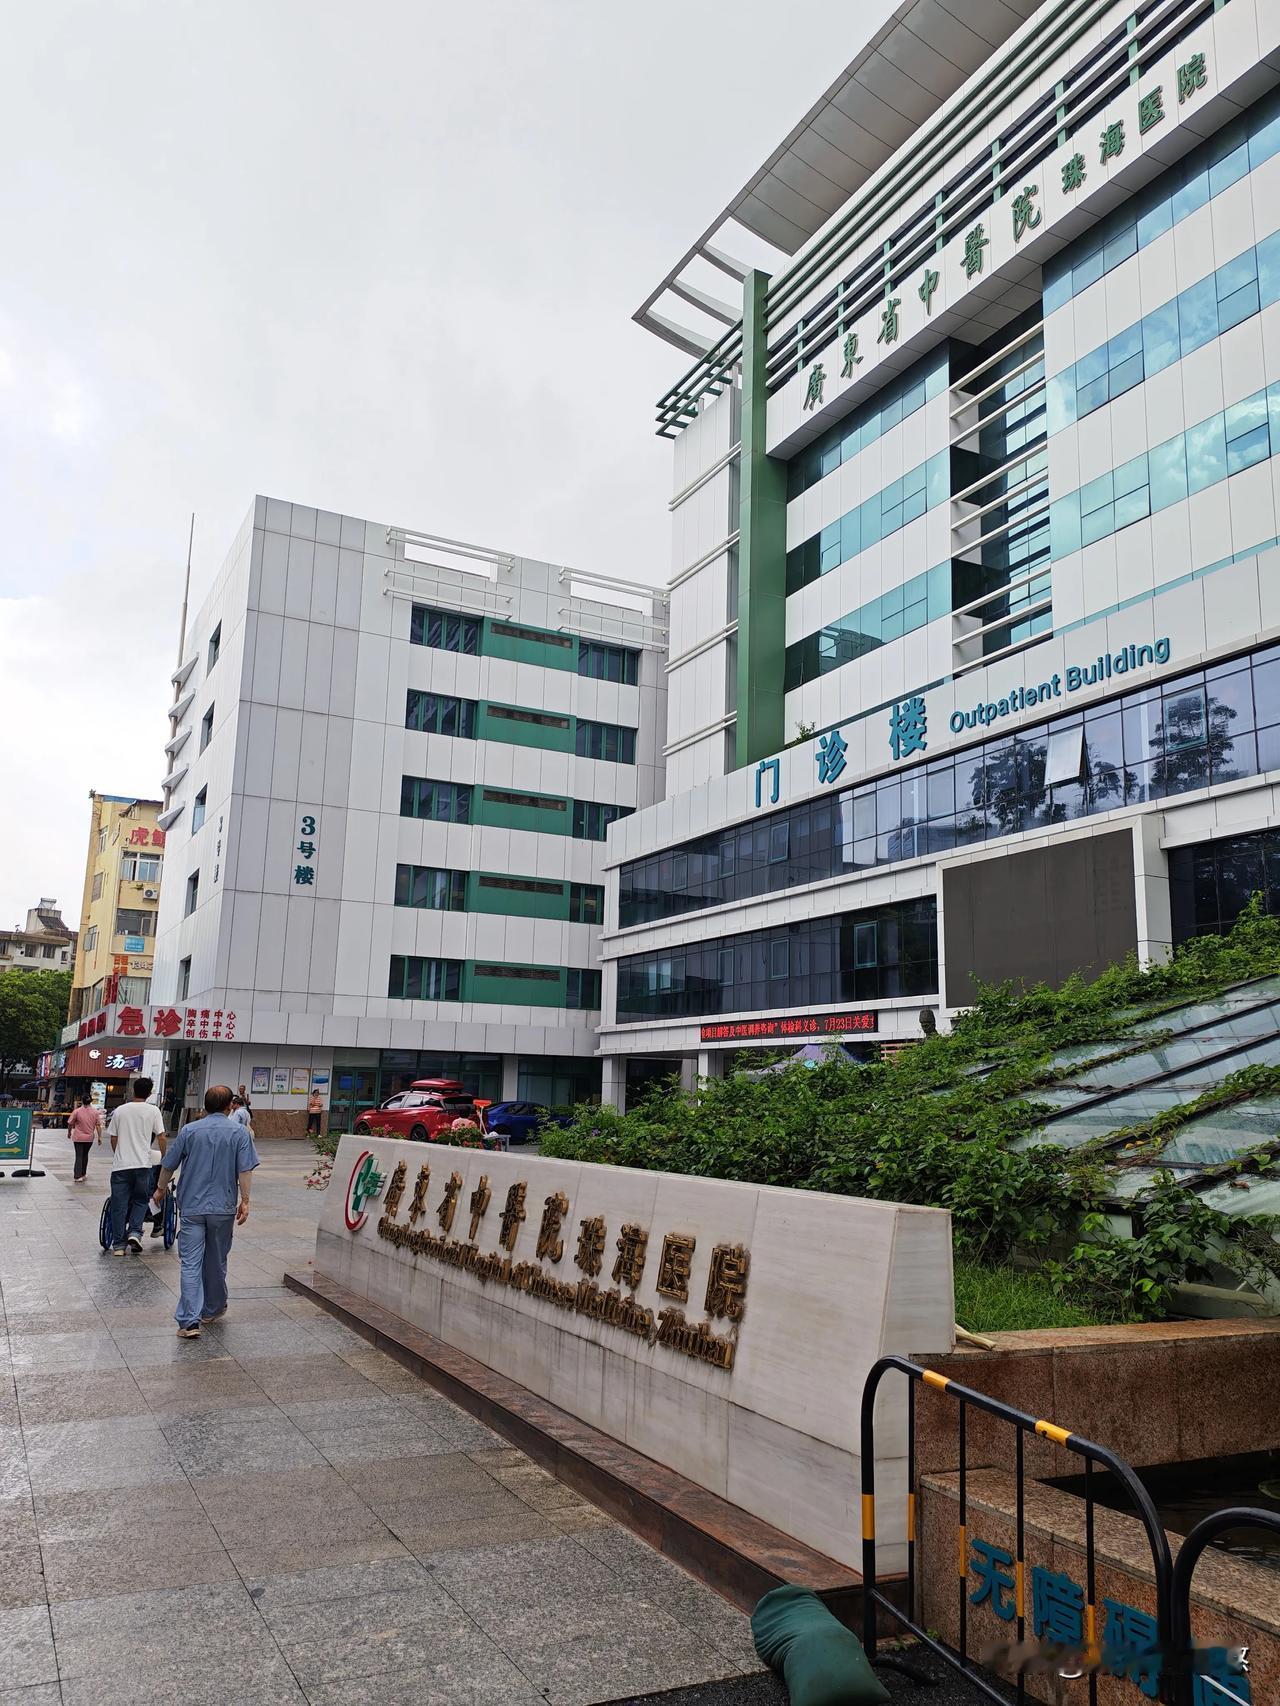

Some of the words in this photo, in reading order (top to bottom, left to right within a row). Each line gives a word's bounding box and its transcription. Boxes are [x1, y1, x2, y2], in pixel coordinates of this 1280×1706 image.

[949, 673, 1062, 734] Outpatient
[1065, 636, 1171, 693] Building
[754, 696, 928, 808] 门诊楼
[293, 815, 316, 886] 3号楼
[116, 1005, 183, 1038] 急诊
[186, 1008, 237, 1020] 胸痛中心
[186, 1018, 236, 1030] 卒中中心
[185, 1028, 235, 1040] 创伤中心
[4, 1114, 21, 1145] 门诊
